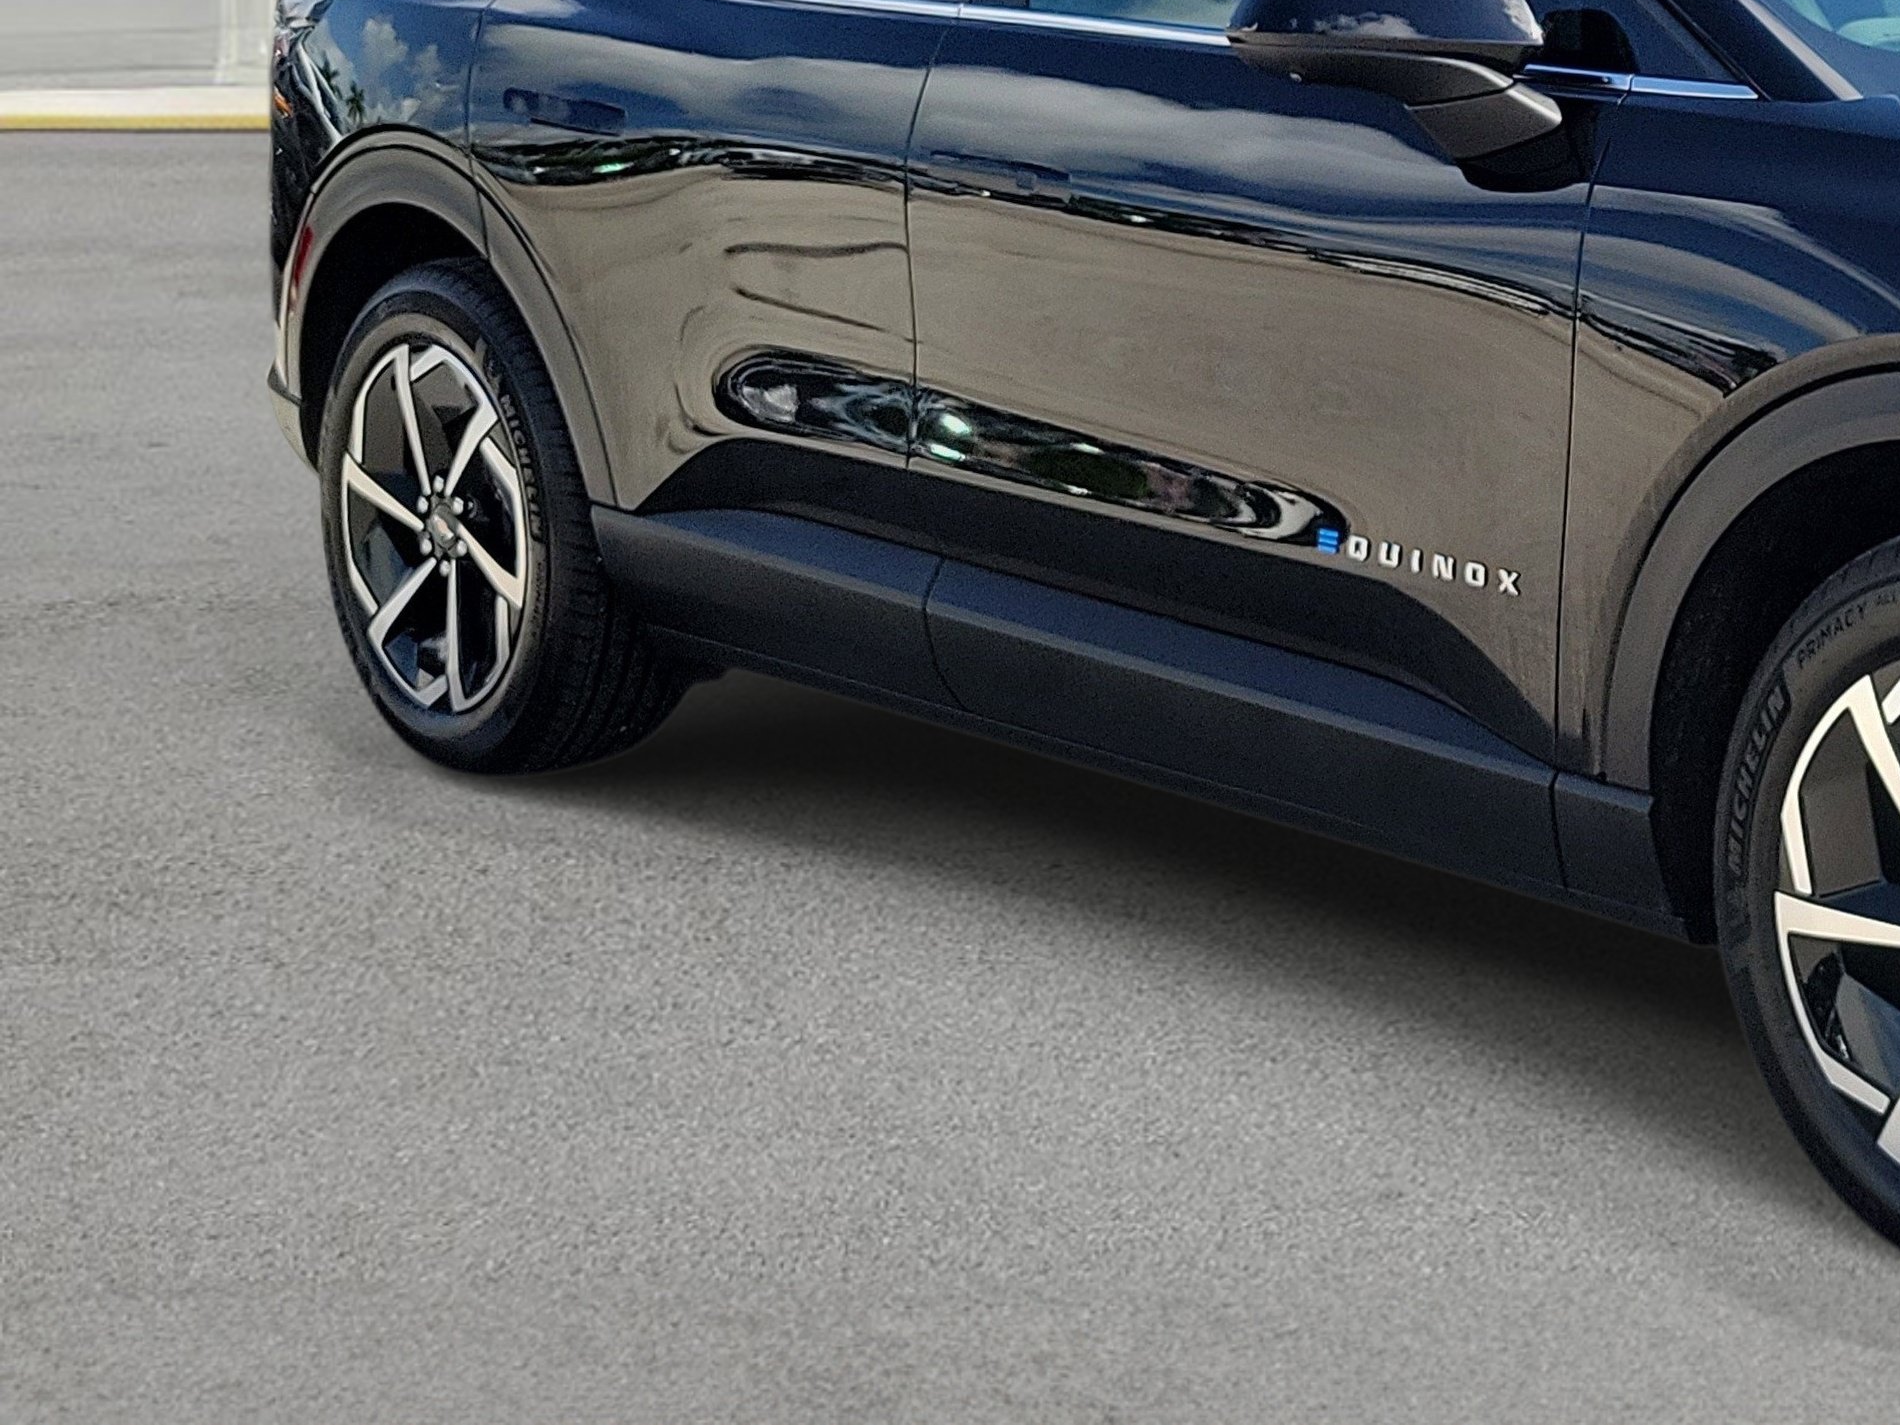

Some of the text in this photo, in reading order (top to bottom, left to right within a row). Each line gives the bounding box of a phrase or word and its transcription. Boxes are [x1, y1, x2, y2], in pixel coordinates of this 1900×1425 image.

[1316, 527, 1521, 597] EQUINOX
[1795, 602, 1867, 669] PRIMACY
[1727, 685, 1785, 876] MICHELIN
